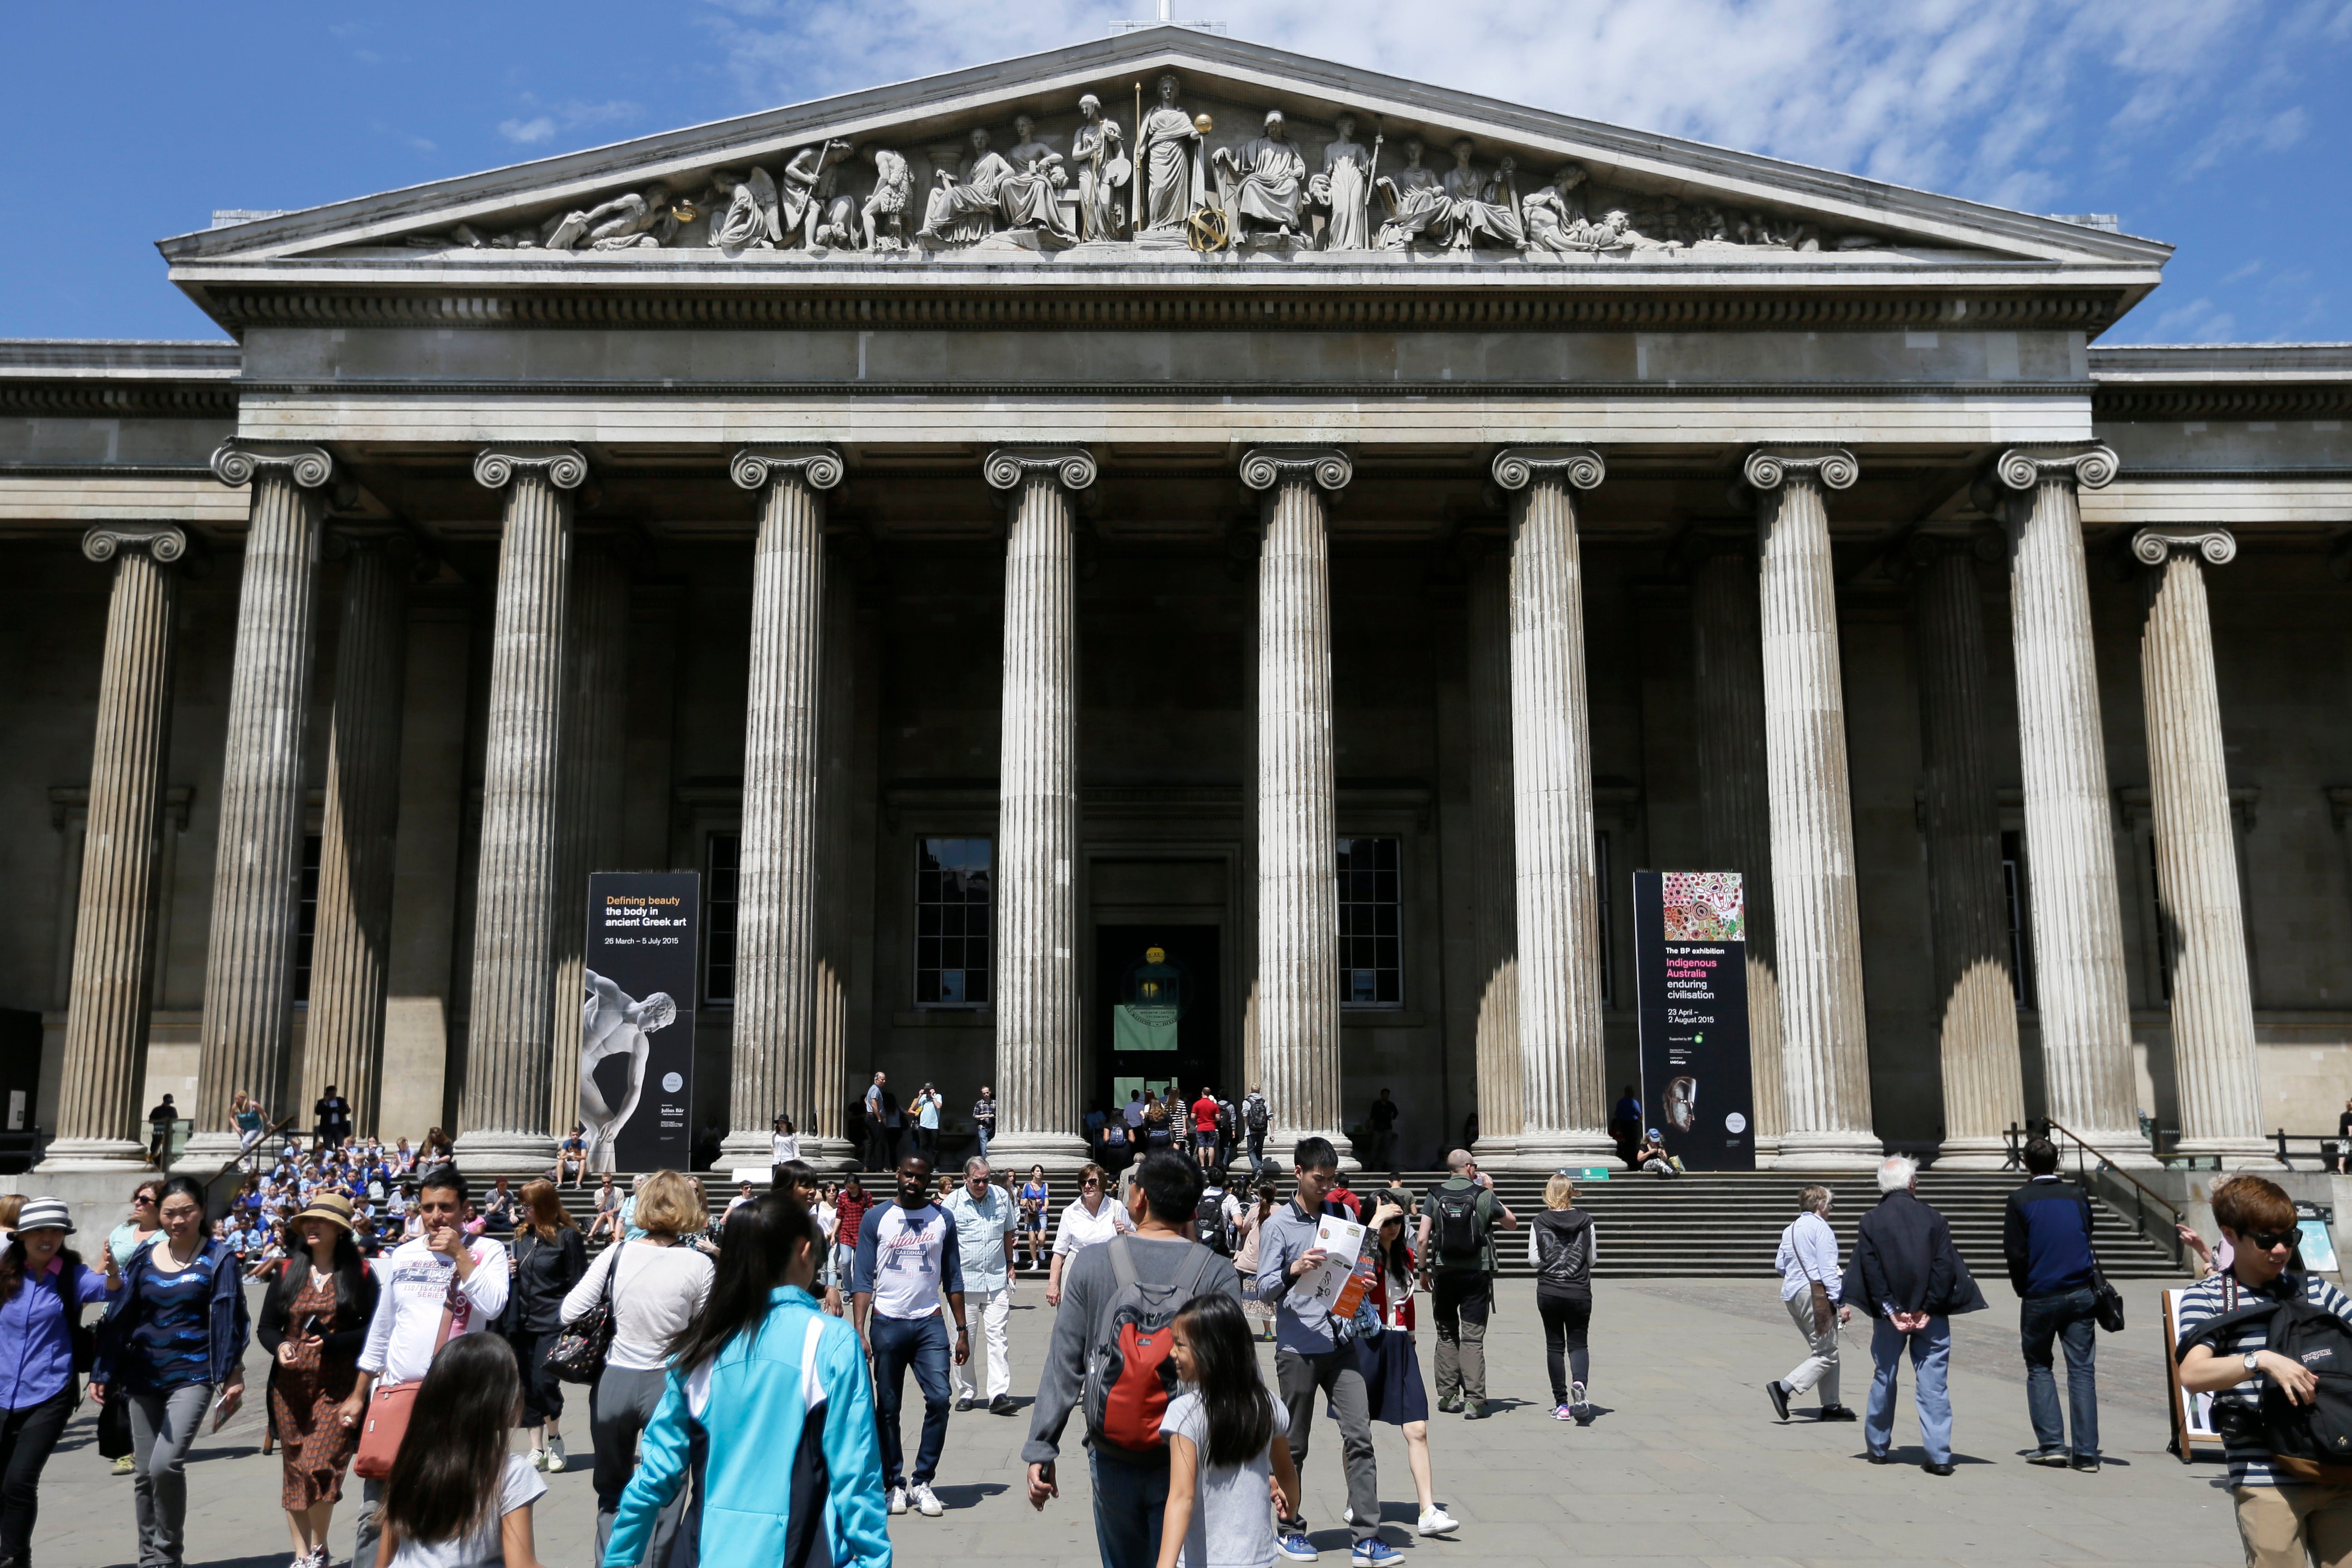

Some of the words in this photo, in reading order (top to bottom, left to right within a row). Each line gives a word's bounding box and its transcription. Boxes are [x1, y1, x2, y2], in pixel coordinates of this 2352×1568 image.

[607, 896, 645, 906] Defining
[648, 896, 680, 906] beauty
[606, 907, 622, 915] the
[624, 907, 647, 916] body
[650, 907, 658, 915] in
[605, 918, 640, 926] ancient
[642, 917, 671, 926] Greek
[673, 918, 686, 926] art
[648, 937, 661, 946] July
[1666, 958, 1717, 968] Indigenous
[1666, 969, 1706, 977] Australia
[1667, 980, 1707, 990] enduring
[1667, 990, 1714, 999] civilisation
[1678, 1009, 1692, 1017] April
[1674, 1016, 1697, 1024] August
[885, 1231, 936, 1250] Atlanta
